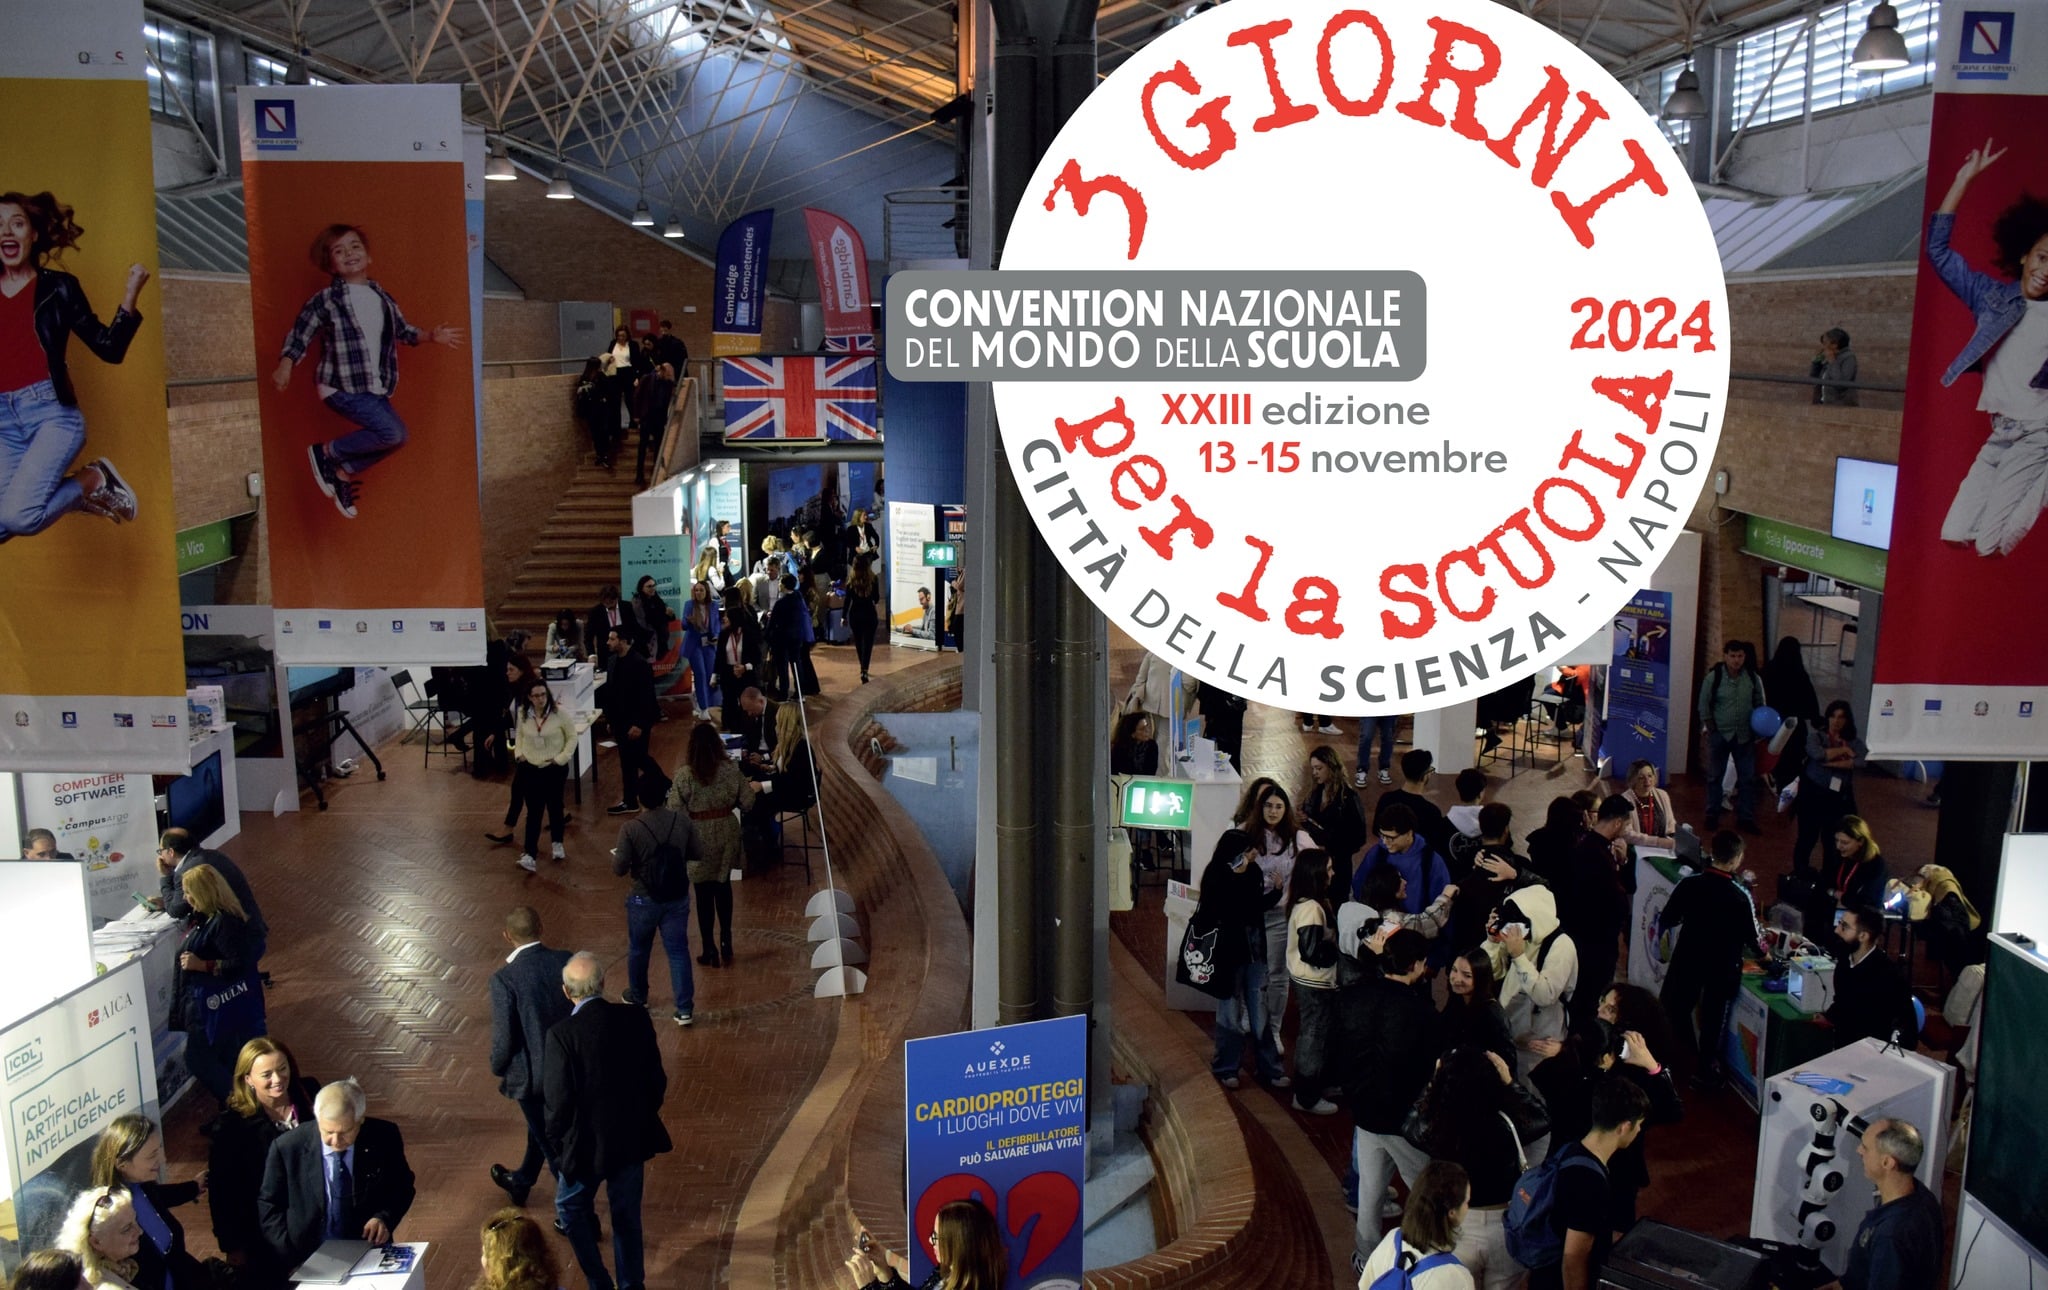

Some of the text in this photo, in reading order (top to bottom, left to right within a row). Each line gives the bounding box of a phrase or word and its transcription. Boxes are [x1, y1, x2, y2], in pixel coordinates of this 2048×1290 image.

[736, 226, 754, 325] Life Competencies
[724, 264, 739, 325] Cambridge
[186, 540, 205, 556] Vico
[1783, 535, 1825, 560] Ippocrate
[53, 773, 125, 794] COMPUTER
[54, 784, 126, 806] SOFTWARE
[101, 992, 133, 1023] AICA
[9, 1048, 38, 1072] ICDL
[965, 1054, 1031, 1074] AUEXDE
[22, 1094, 56, 1127] ICDL
[915, 1078, 1083, 1122] CARDIOPROTEGGI
[24, 1087, 101, 1147] ARTIFICIAL
[26, 1088, 126, 1167] INTELLIGENCE
[938, 1097, 1083, 1136] I LUOGHI DOVE VIVI
[960, 1135, 1083, 1167] PUÒ SALVARE UNA VITA!
[986, 1125, 1080, 1151] IL DEFIBRILLATORE
